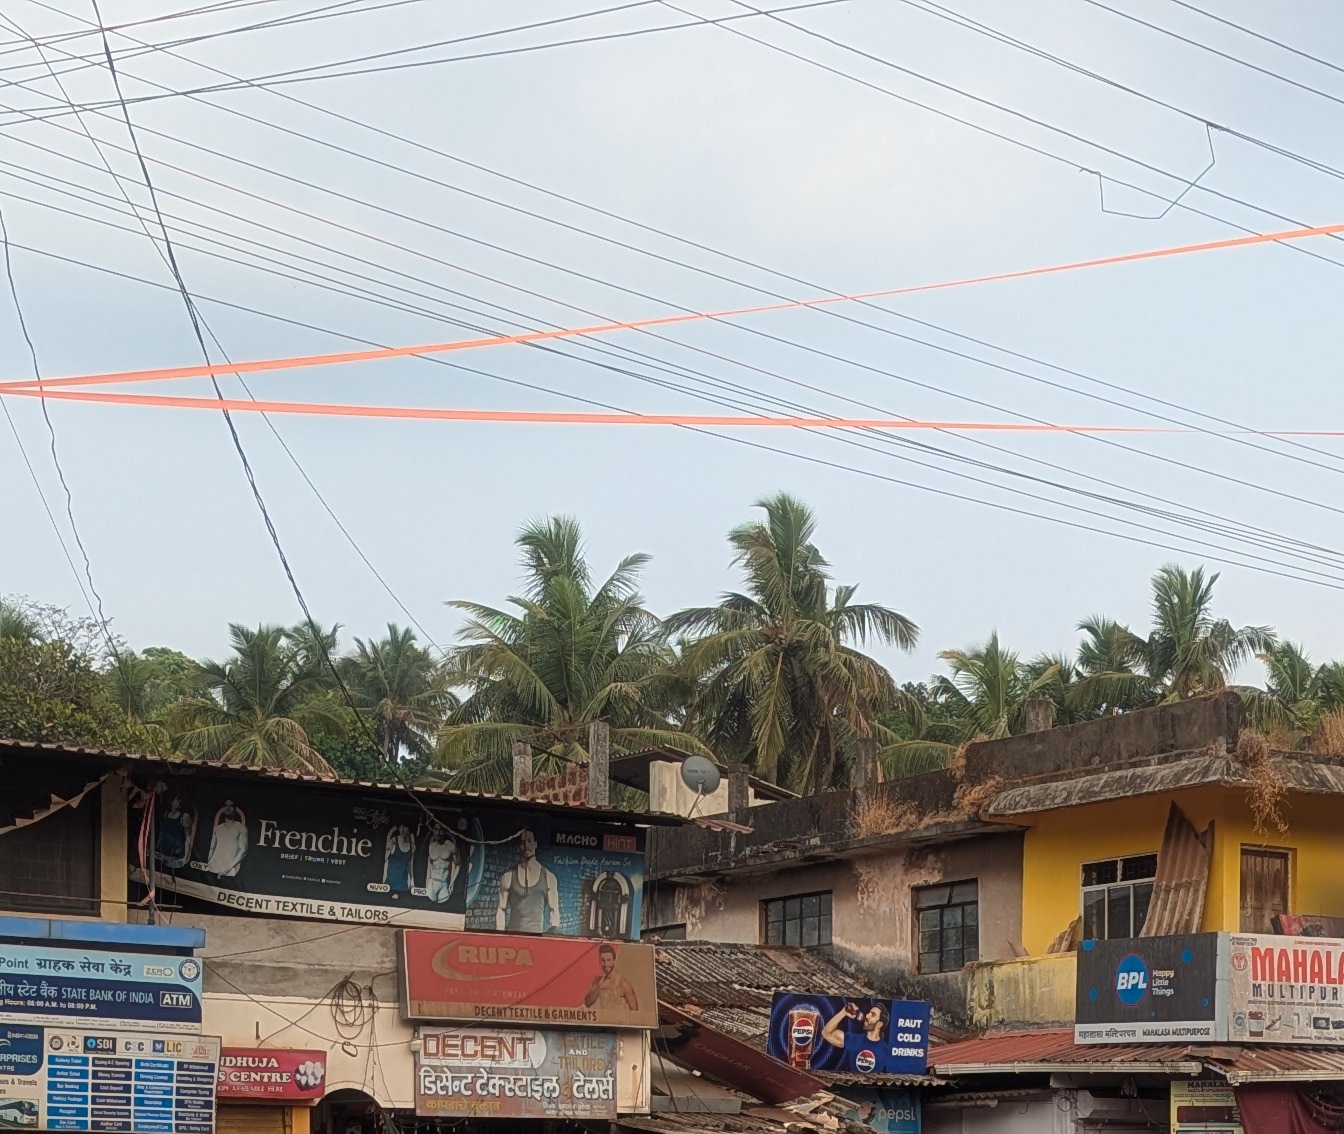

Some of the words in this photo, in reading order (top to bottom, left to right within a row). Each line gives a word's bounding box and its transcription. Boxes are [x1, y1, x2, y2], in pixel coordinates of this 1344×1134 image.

[256, 819, 372, 858] Frenchie
[556, 832, 597, 846] MACHO
[217, 891, 272, 911] DECENT
[275, 900, 325, 917] TEXTILE
[328, 906, 337, 917] &
[339, 907, 389, 922] TAILORS
[458, 945, 533, 966] RUPA
[35, 956, 76, 974] ग्राहक
[79, 957, 106, 974] सेवा
[1117, 971, 1148, 991] BPL
[1152, 969, 1175, 979] Happy
[17, 981, 38, 997] स्टेट
[40, 979, 58, 999] बैंक
[61, 987, 87, 1000] STATE
[89, 988, 114, 1002] BANK
[115, 990, 127, 1002] OF
[129, 991, 154, 1004] INDIA
[1152, 988, 1174, 997] Things
[162, 992, 192, 1007] ATM
[474, 1005, 507, 1017] DECENT
[509, 1007, 543, 1019] TEXTILE
[544, 1010, 551, 1019] &
[552, 1009, 597, 1021] GARMENTS
[897, 1018, 923, 1029] RAUT
[793, 1028, 813, 1037] PEPSI
[897, 1032, 922, 1043] COLD
[1142, 1028, 1171, 1037] MAHALASA
[97, 1038, 113, 1050] SBI
[166, 1041, 182, 1053] LIC
[422, 1033, 536, 1063] DECENT
[892, 1047, 925, 1058] DRINKS
[221, 1056, 279, 1068] NDHUJA
[229, 1072, 291, 1083] CENTRE
[419, 1066, 473, 1097] डिसेन्ट
[475, 1067, 560, 1101] टेक्स्टाइल
[572, 1069, 615, 1100] टेलर्स
